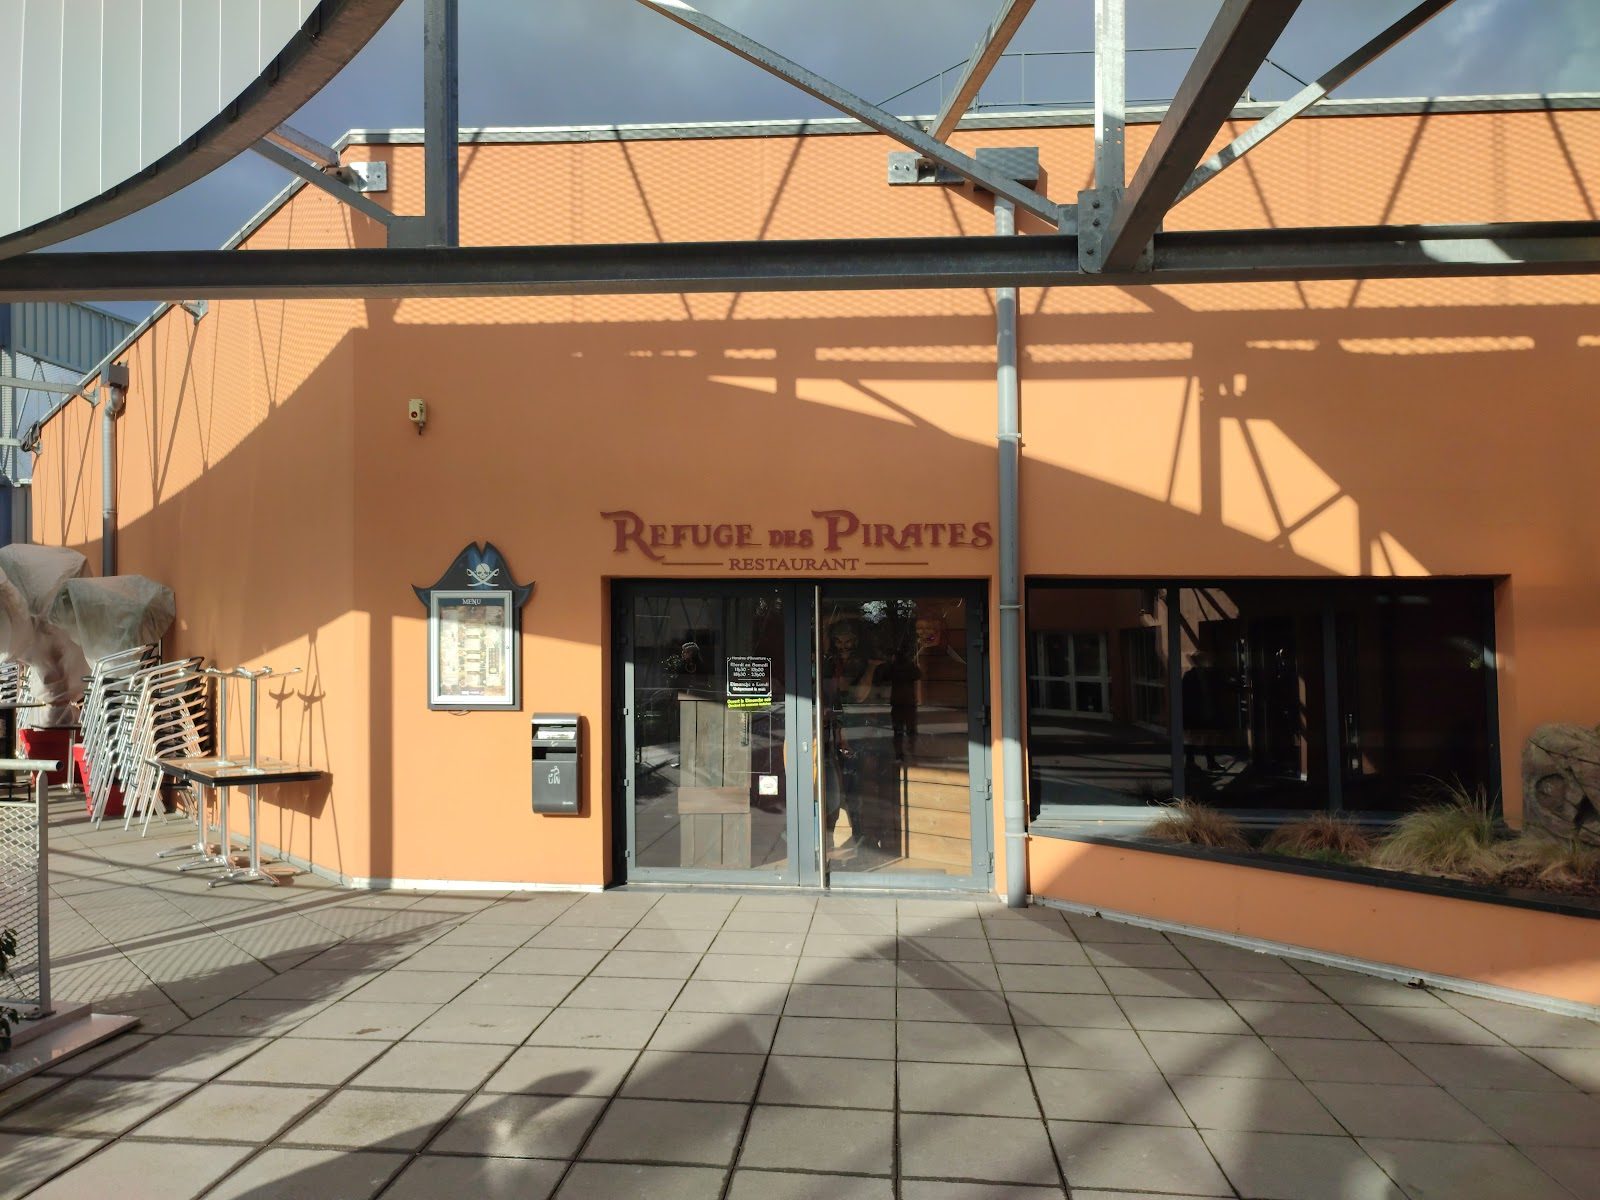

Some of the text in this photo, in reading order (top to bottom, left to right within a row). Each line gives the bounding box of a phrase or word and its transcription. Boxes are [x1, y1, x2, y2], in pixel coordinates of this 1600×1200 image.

[600, 509, 993, 561] REFUGE DES PIRATES
[728, 558, 859, 571] RESTAURANT
[462, 598, 482, 606] MENU
